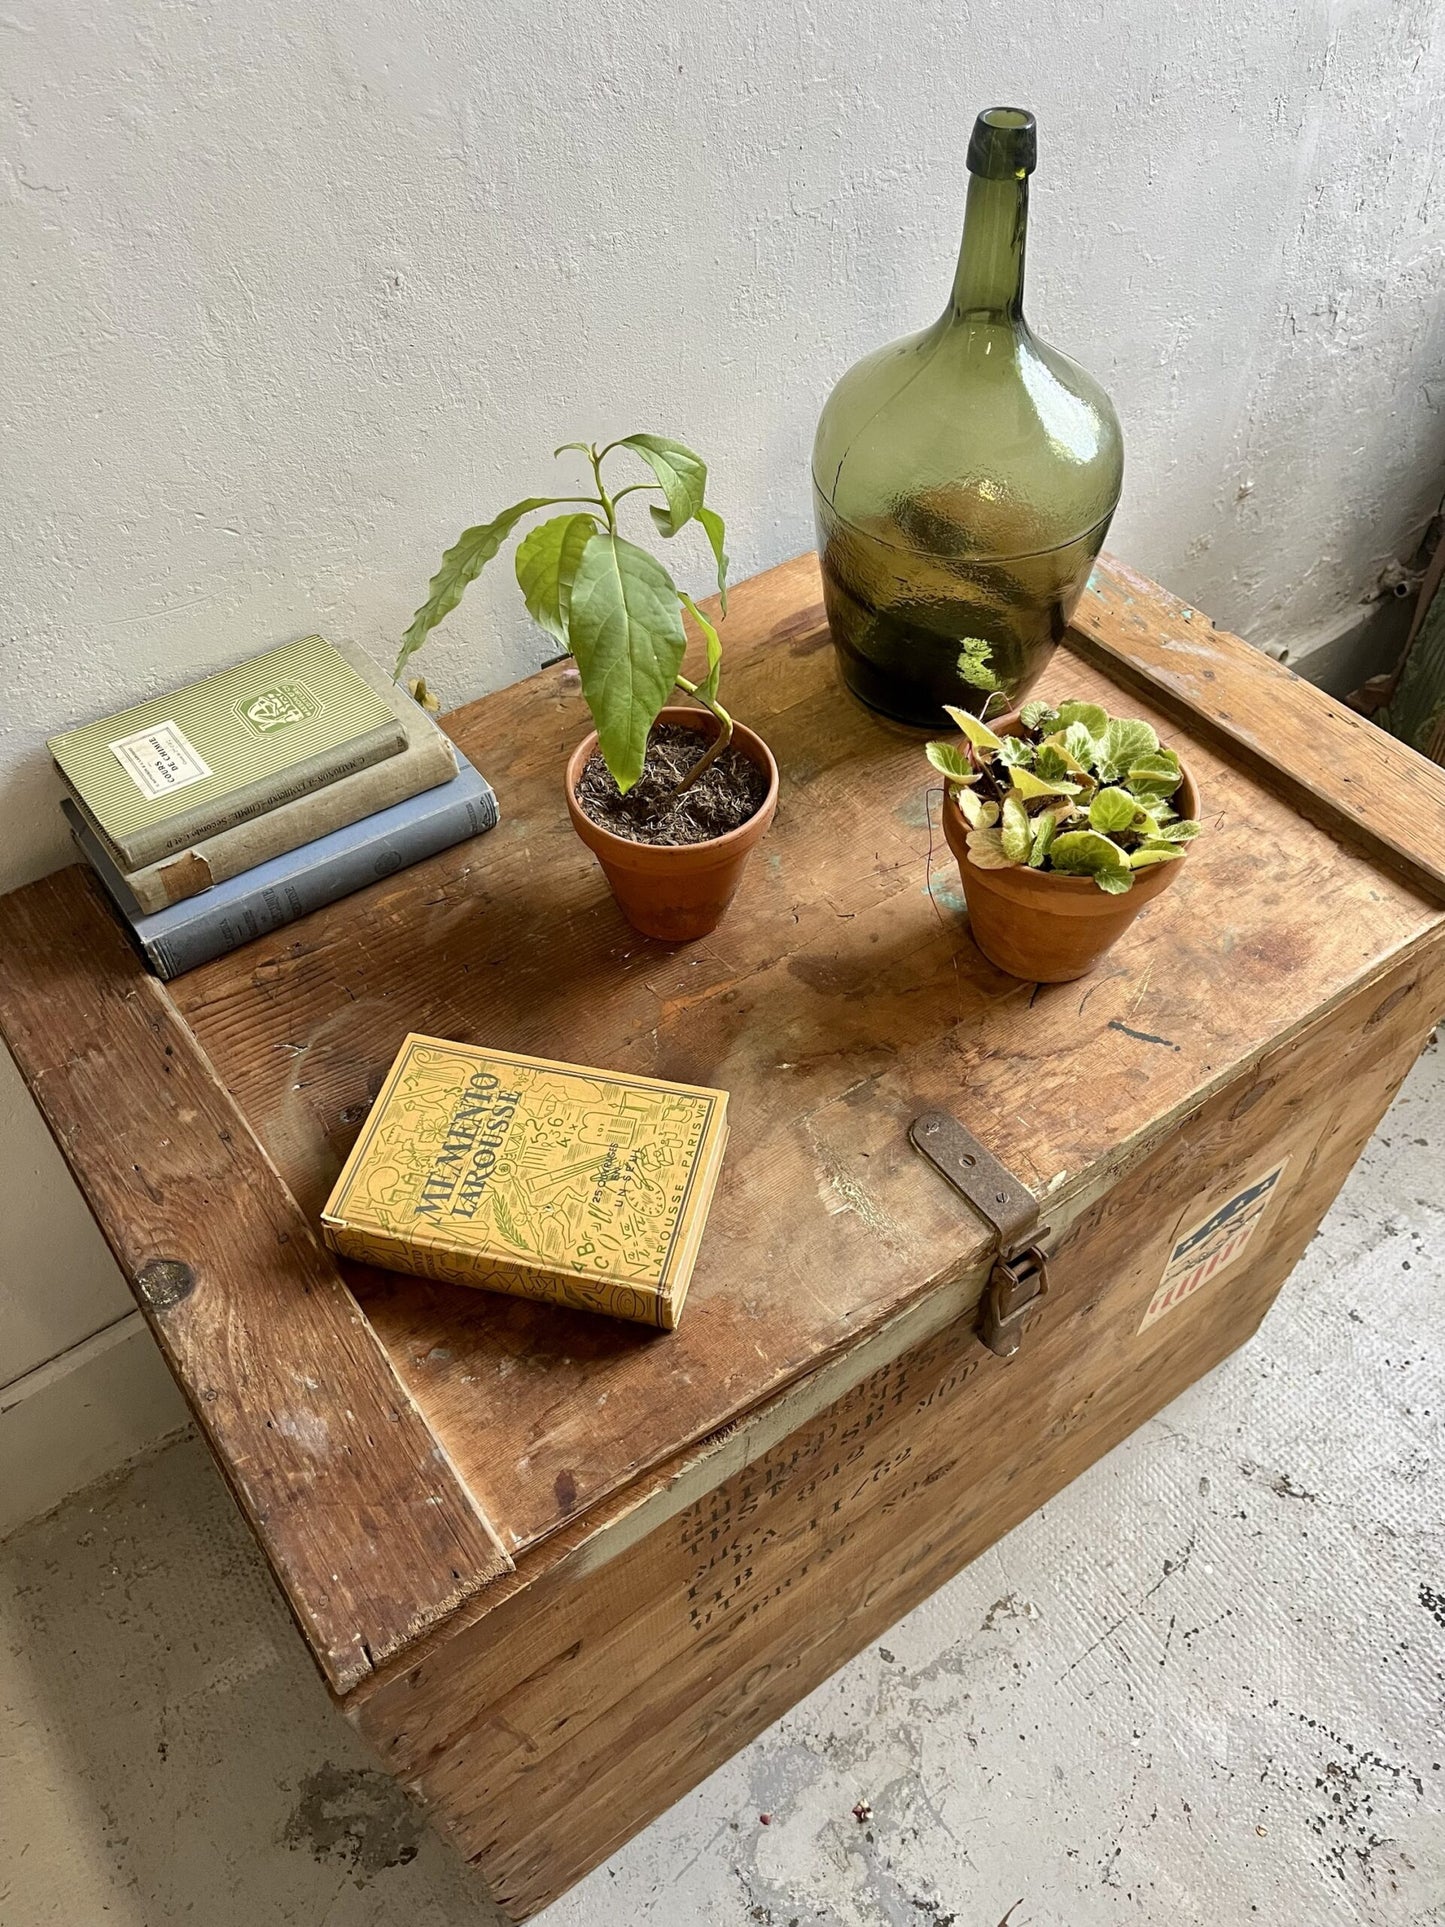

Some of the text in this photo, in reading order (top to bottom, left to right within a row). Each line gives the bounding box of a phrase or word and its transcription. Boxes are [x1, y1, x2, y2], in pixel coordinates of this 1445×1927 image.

[148, 736, 171, 761] CHIMIE
[154, 761, 175, 783] COURS
[167, 761, 179, 772] DE
[413, 1072, 500, 1224] MEMENTO
[451, 1090, 522, 1219] LAROUSSE
[591, 1189, 603, 1203] 25
[614, 1188, 628, 1207] UN
[648, 1183, 685, 1277] LAROUSSE
[681, 1122, 701, 1167] PARIS
[682, 1423, 835, 1543] GUIDED
[686, 1387, 908, 1559] TEST SET
[730, 1531, 852, 1629] SERIAL
